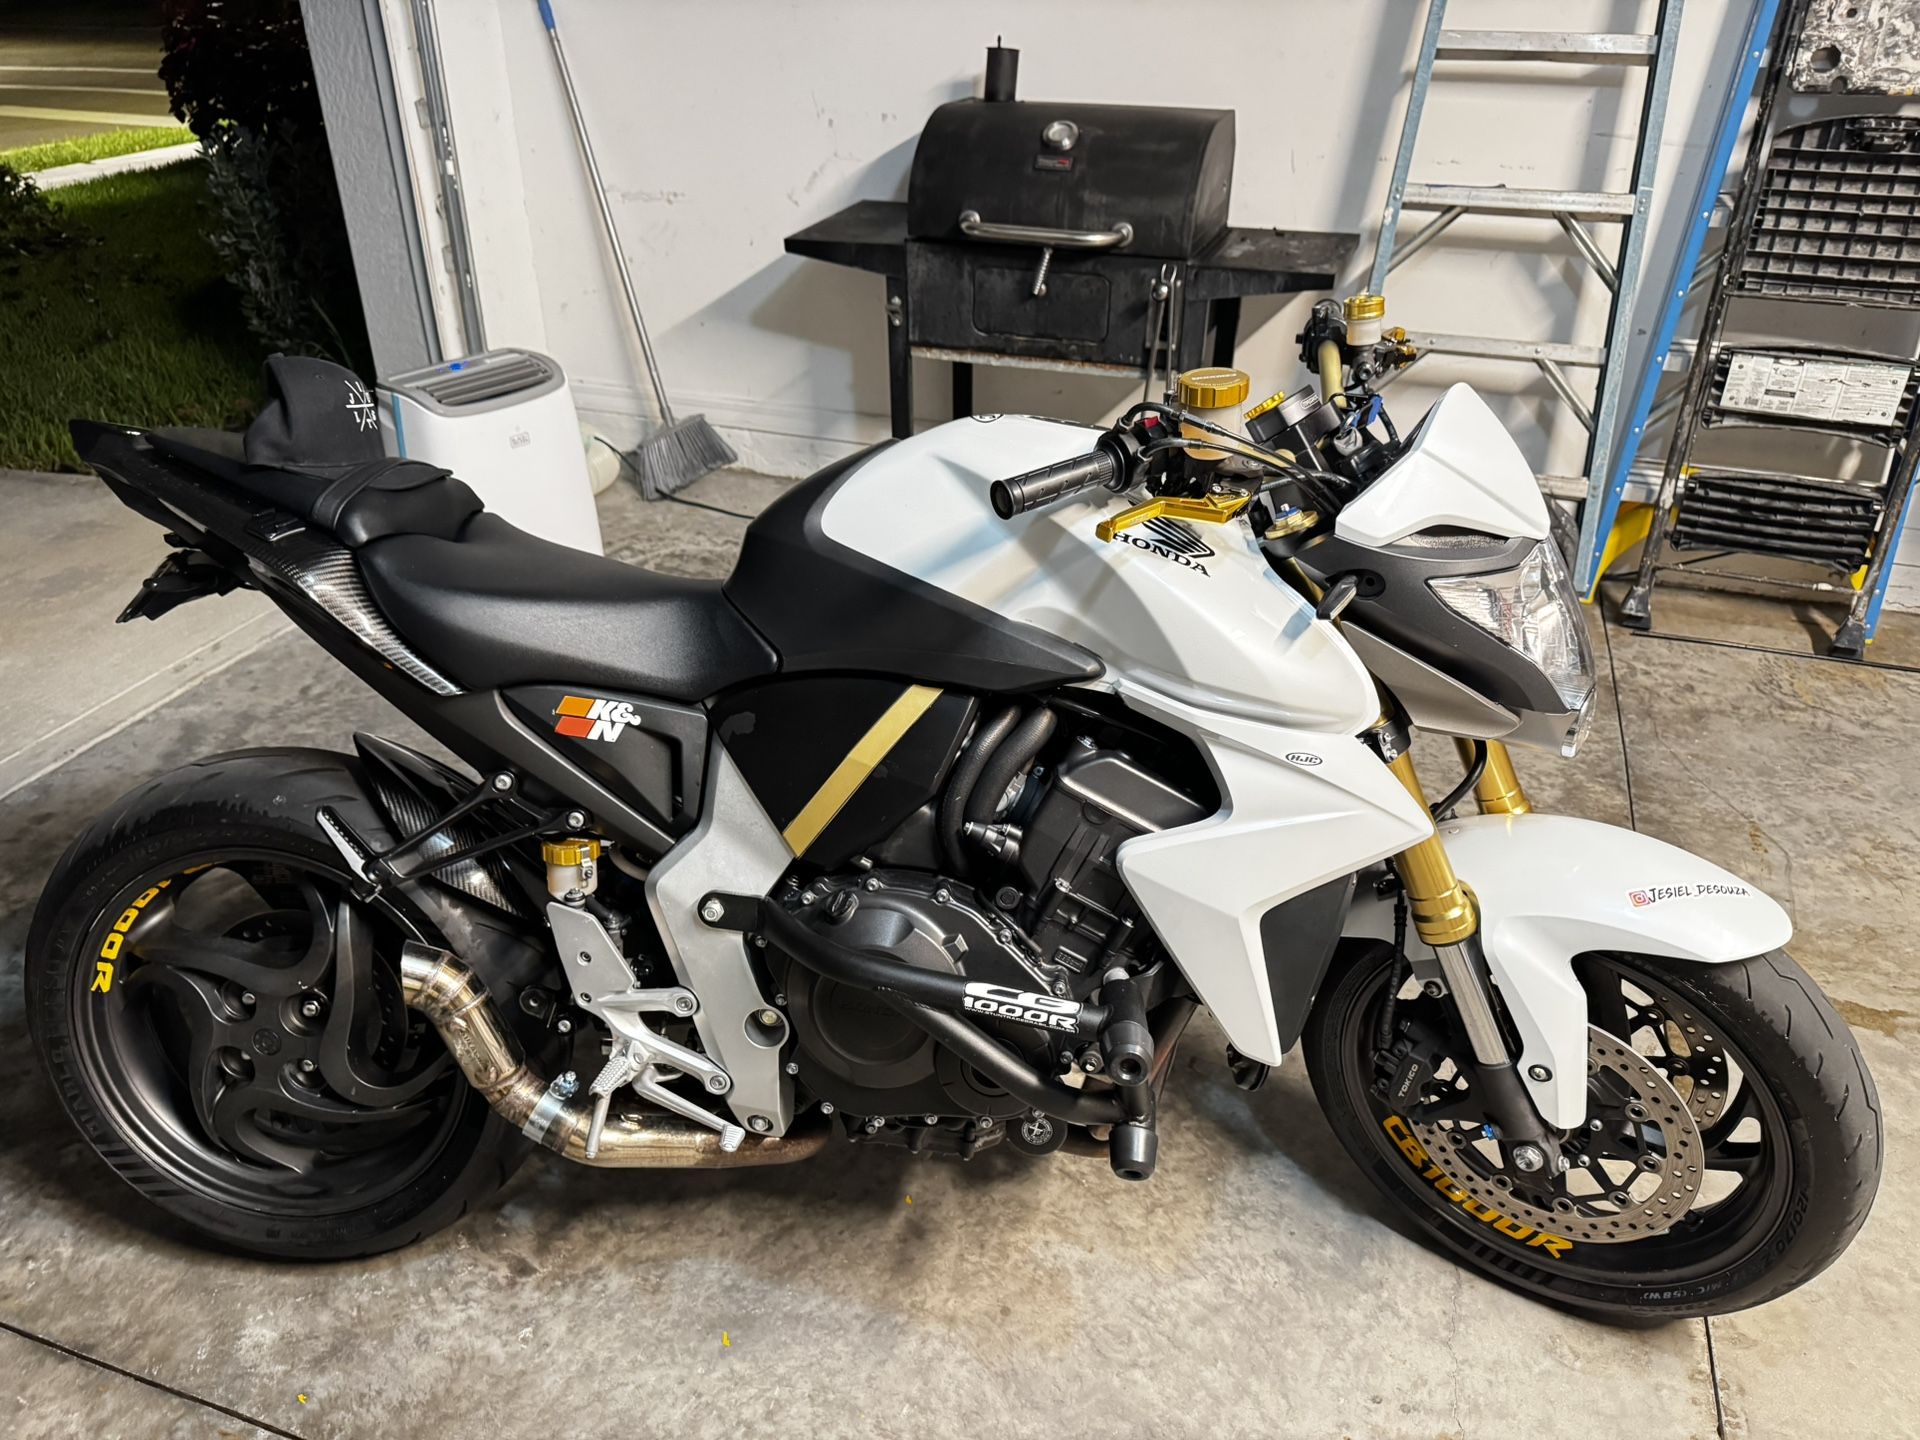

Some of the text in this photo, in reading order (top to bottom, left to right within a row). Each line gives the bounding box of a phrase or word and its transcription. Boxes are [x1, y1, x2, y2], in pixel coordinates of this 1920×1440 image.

[1112, 531, 1211, 578] HONDA
[1290, 754, 1319, 764] HJC
[963, 996, 1077, 1030] 1000R
[965, 982, 1080, 1014] CB
[1398, 1063, 1418, 1098] TOKICO
[1382, 1115, 1573, 1259] CB1000R
